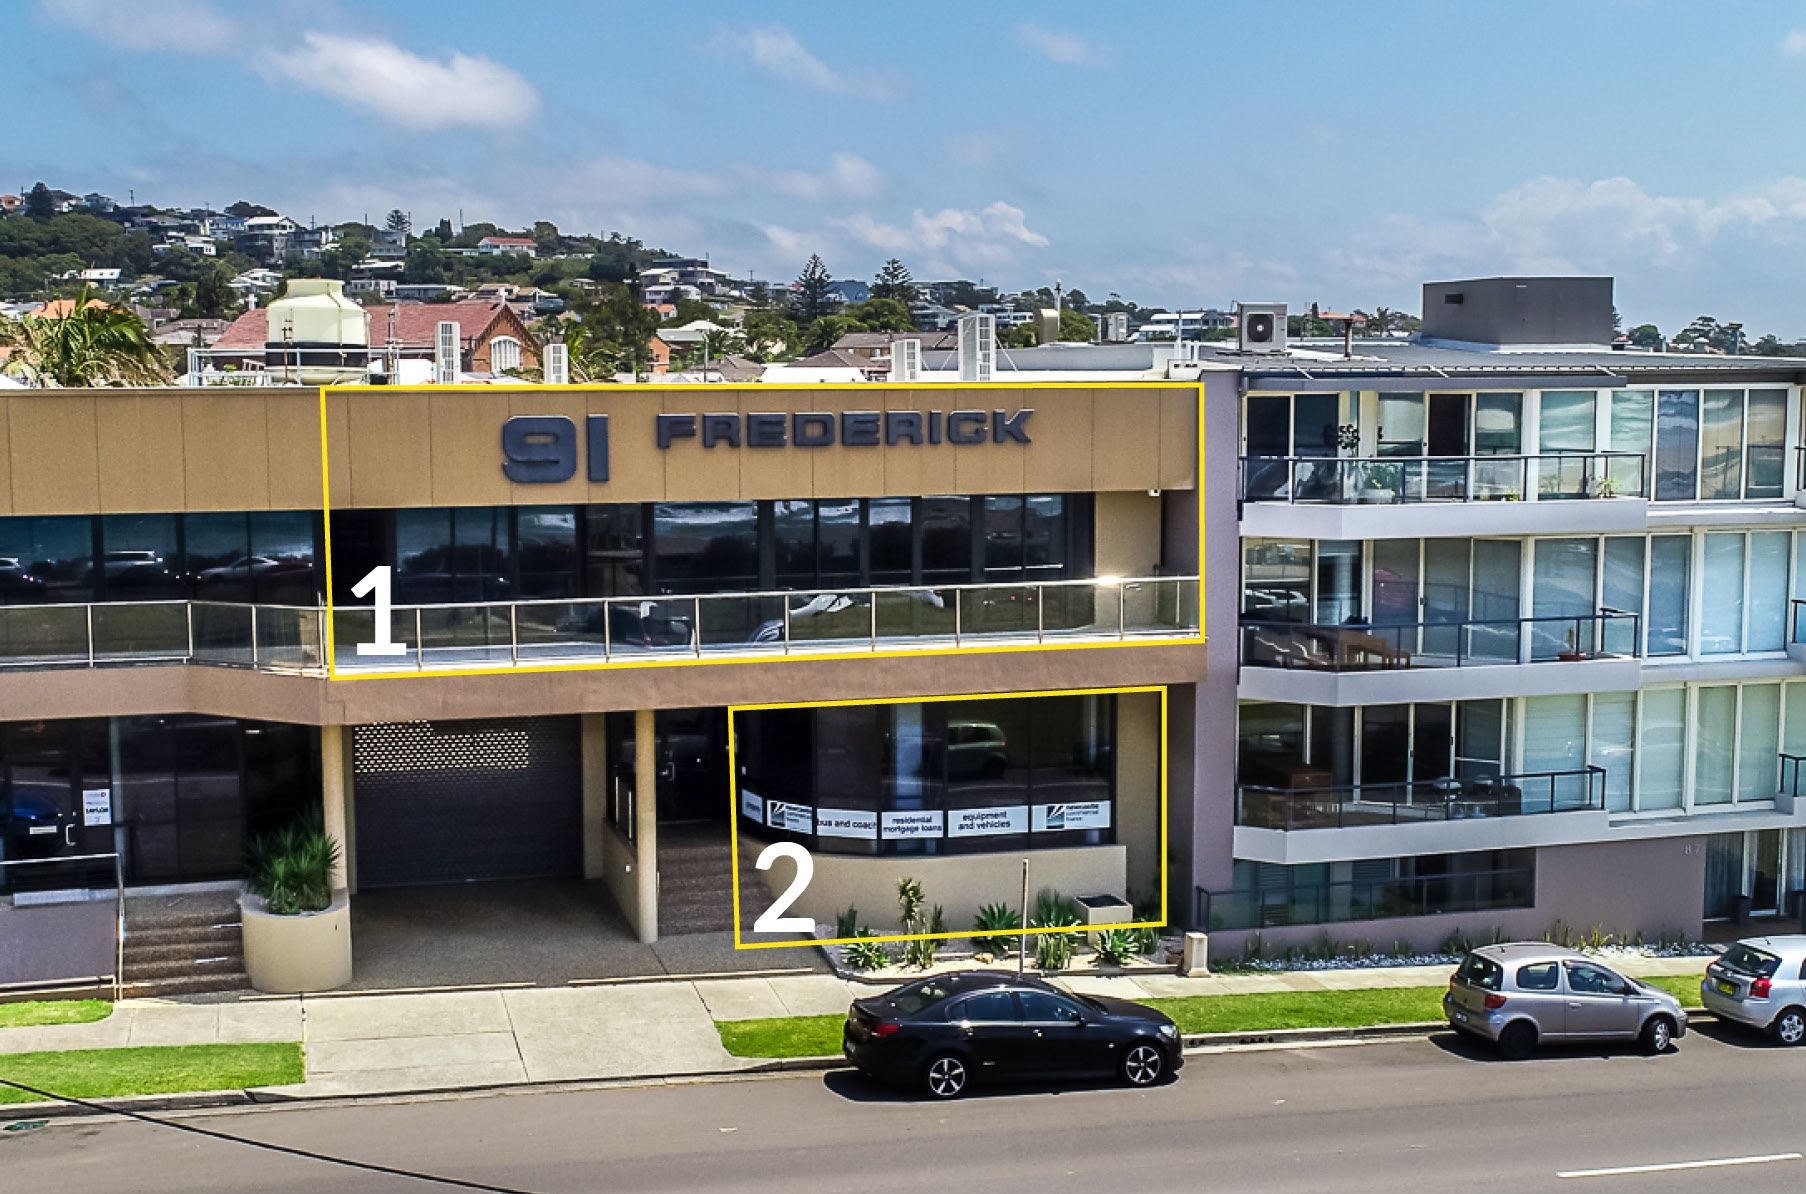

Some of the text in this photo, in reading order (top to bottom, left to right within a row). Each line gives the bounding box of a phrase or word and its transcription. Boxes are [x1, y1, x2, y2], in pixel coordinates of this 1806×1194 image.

[656, 407, 1036, 450] FREDERICK
[892, 816, 933, 825] residential
[962, 809, 1007, 824] equipment
[834, 819, 851, 828] and
[883, 823, 943, 835] mortgage loans
[957, 819, 1011, 831] and vehicles
